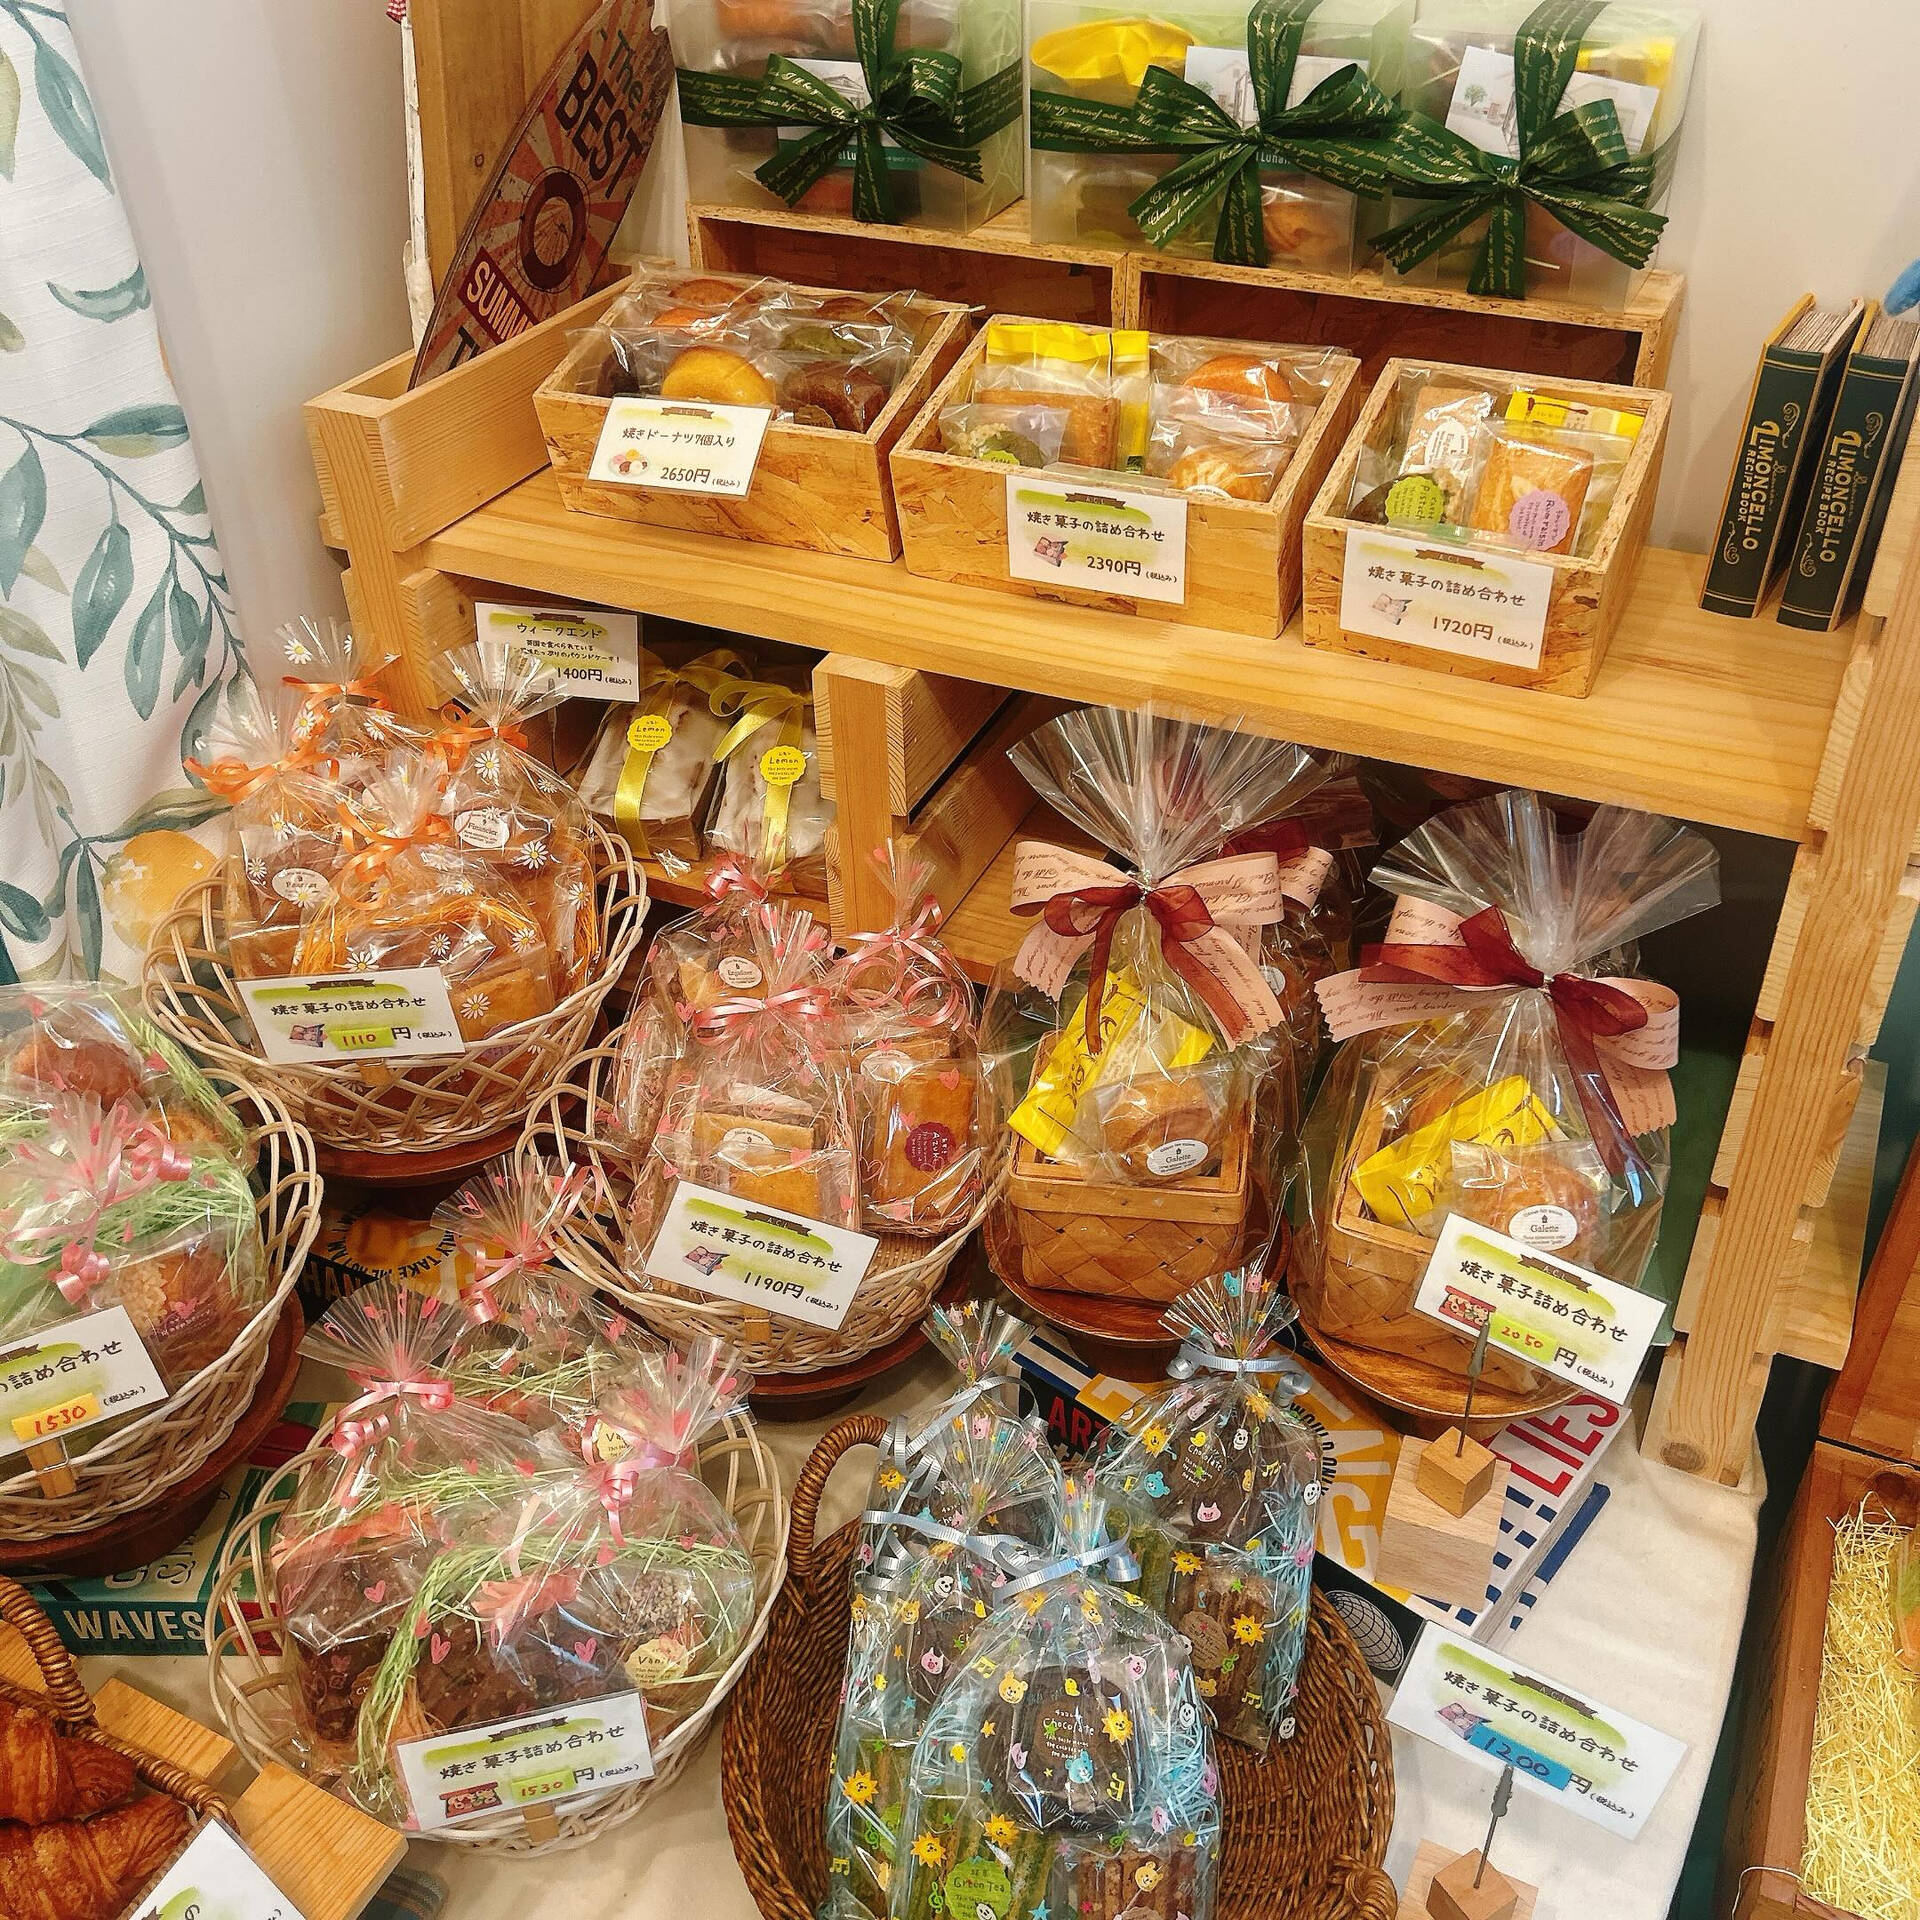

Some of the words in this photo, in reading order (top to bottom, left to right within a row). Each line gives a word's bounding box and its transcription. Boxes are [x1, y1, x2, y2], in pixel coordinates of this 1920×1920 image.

[555, 50, 644, 199] BEST
[467, 261, 537, 345] SUMM
[622, 427, 735, 448] 焼きドーナツ7個入り
[660, 467, 711, 484] 2650円
[1742, 450, 1755, 489] RECIPE
[1821, 460, 1836, 501] RECIPE
[1742, 420, 1780, 550] LIMONCELLO
[1819, 430, 1862, 563] LIMONCELLO
[1737, 491, 1751, 522] BOOK
[1815, 502, 1829, 534] BOOK
[1027, 511, 1165, 542] 焼き菓子の詰め合わせ
[1086, 555, 1142, 577] 2390円
[1367, 566, 1526, 607] 焼き菓子の詰め合わせ
[516, 622, 602, 639] ウィークエンド
[1433, 616, 1494, 641] 1720円
[556, 667, 602, 683] 1400円
[636, 725, 665, 734] Lemon
[769, 756, 799, 765] Lemon
[271, 997, 426, 1015] 焼き菓子の詰め合わせ
[342, 1033, 377, 1047] 1110
[391, 1027, 411, 1040] 円
[689, 1220, 843, 1274] 焼き菓子の詰め合わせ
[398, 1254, 443, 1279] TAKE
[743, 1271, 805, 1300] 1190円
[1459, 1260, 1629, 1342] 焼き菓子詰め合わせ
[1553, 1347, 1577, 1369] 円
[1576, 1365, 1615, 1389] (税込み)
[34, 1405, 87, 1435] 1530
[1187, 1444, 1223, 1473] Chocolate
[63, 1610, 205, 1640] WAVES
[1043, 1717, 1095, 1736] Chocolate
[1442, 1670, 1638, 1773] 焼き菓子の詰め合わせ
[440, 1725, 625, 1779] 焼き菓子詰め合わせ
[1483, 1736, 1550, 1777] 1200
[1569, 1772, 1593, 1795] 円
[521, 1780, 564, 1797] 1530
[574, 1767, 595, 1784] 円
[953, 1876, 985, 1891] Green
[986, 1879, 1005, 1893] Tea
